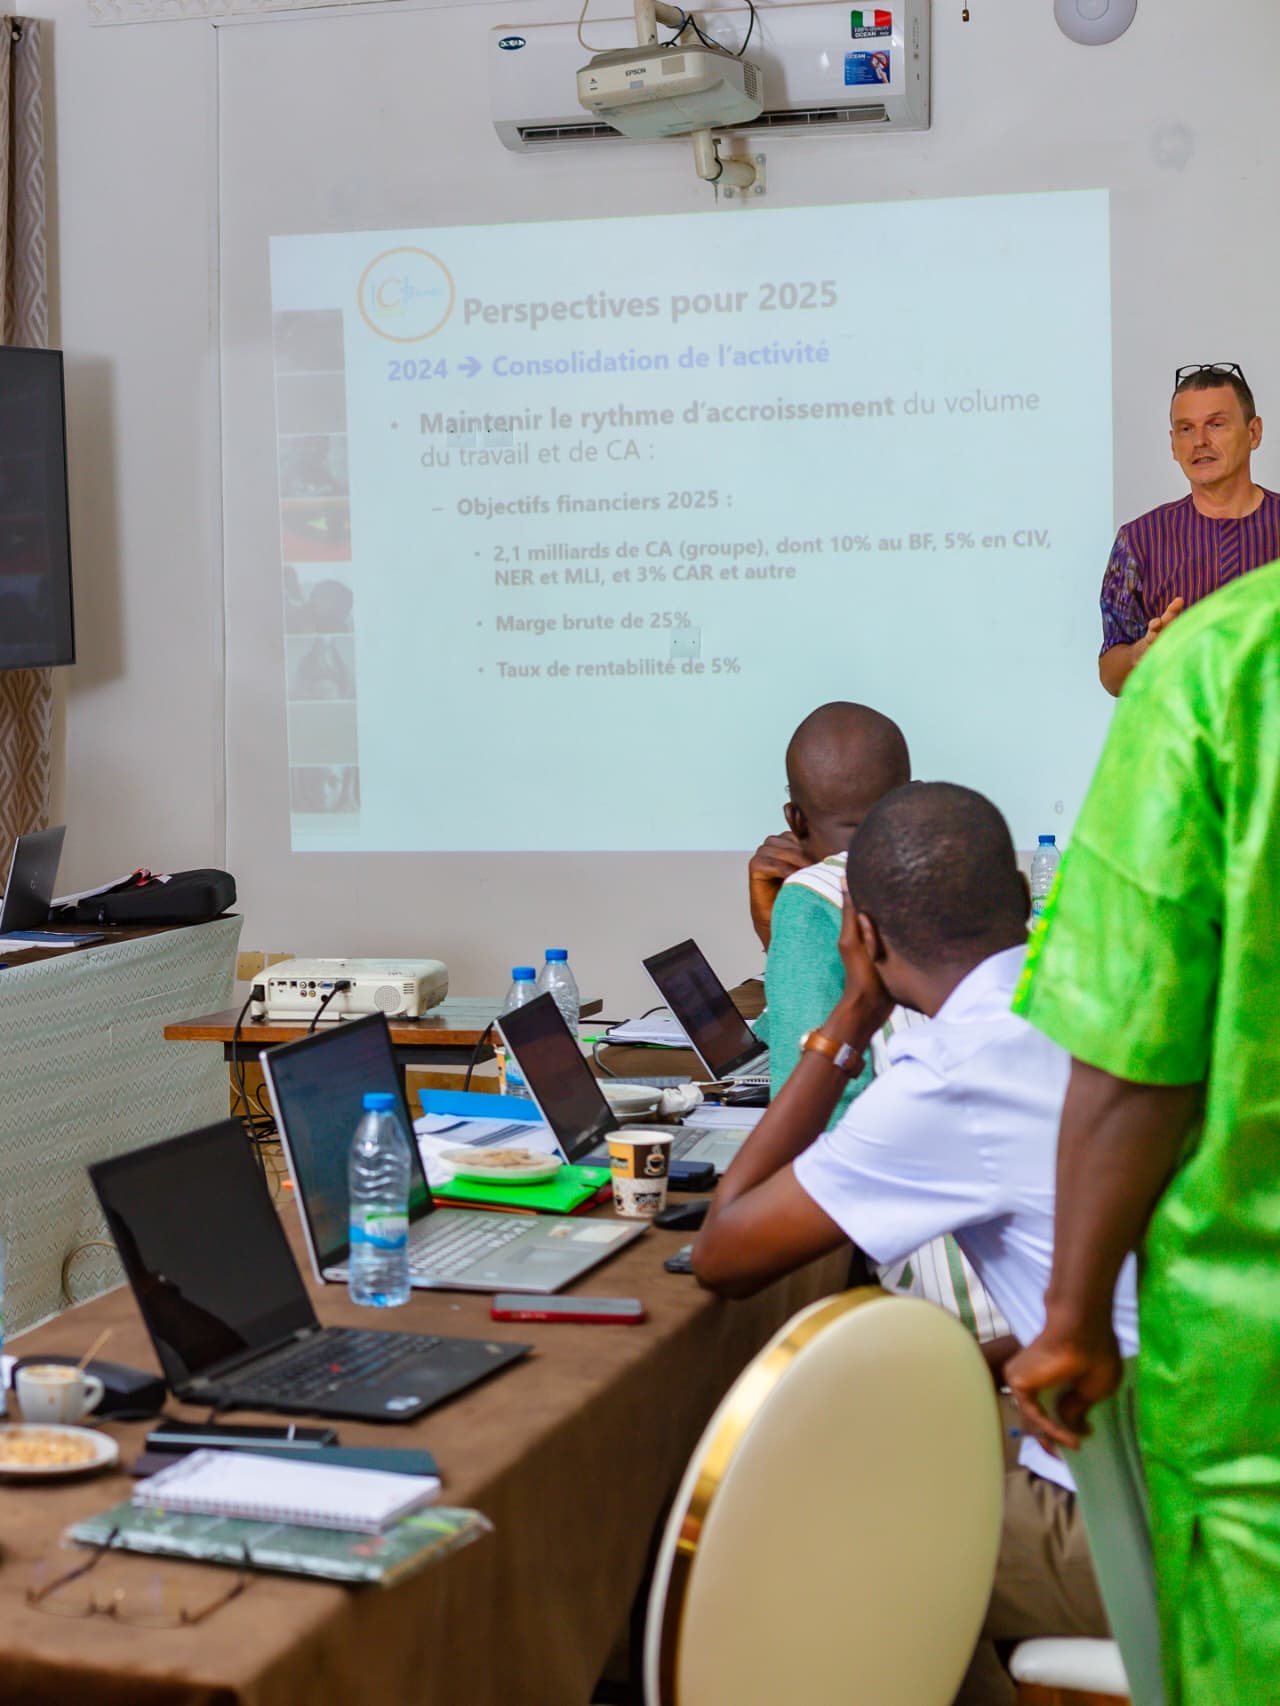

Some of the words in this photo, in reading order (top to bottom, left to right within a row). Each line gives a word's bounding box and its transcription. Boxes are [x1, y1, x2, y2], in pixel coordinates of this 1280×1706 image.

[463, 290, 660, 331] Perspectives
[671, 291, 749, 324] pour
[758, 279, 838, 312] 2025
[387, 356, 449, 382] 2024
[491, 348, 670, 377] Consolidation
[677, 345, 710, 369] de
[718, 338, 830, 368] l'activité
[419, 408, 543, 435] Maintenir
[550, 406, 573, 430] le
[580, 402, 675, 434] rythme
[681, 396, 895, 425] d'accroissement
[903, 390, 935, 416] du
[943, 387, 1040, 414] volume
[419, 444, 450, 468] du
[459, 441, 529, 467] travail
[537, 443, 561, 464] et
[568, 440, 599, 463] de
[606, 438, 641, 462] CA
[456, 494, 551, 520] Objectifs
[556, 491, 661, 513] financiers
[667, 489, 719, 510] 2025
[493, 545, 520, 564] 2,1
[527, 542, 611, 561] milliards
[615, 541, 640, 559] de
[645, 540, 673, 558] CA
[678, 538, 769, 562] (groupe),
[775, 536, 824, 555] dont
[829, 535, 872, 553] 10%
[878, 537, 903, 552] au
[908, 532, 937, 553] BF,
[944, 531, 976, 550] 5%
[980, 533, 1007, 549] en
[1012, 528, 1052, 550] CIV,
[494, 568, 535, 587] NER
[539, 569, 559, 585] et
[564, 567, 606, 587] MLI,
[612, 567, 631, 584] et
[636, 565, 667, 583] 3%
[672, 564, 714, 582] CAR
[719, 564, 739, 581] et
[744, 563, 797, 580] autre
[495, 614, 557, 636] Marge
[562, 613, 615, 631] brute
[620, 611, 644, 630] de
[649, 610, 692, 630] 25%
[495, 660, 541, 679] Taux
[546, 660, 571, 678] de
[575, 657, 676, 678] rentabilité
[680, 657, 705, 676] de
[711, 656, 741, 675] 5%
[1054, 799, 1065, 815] 6
